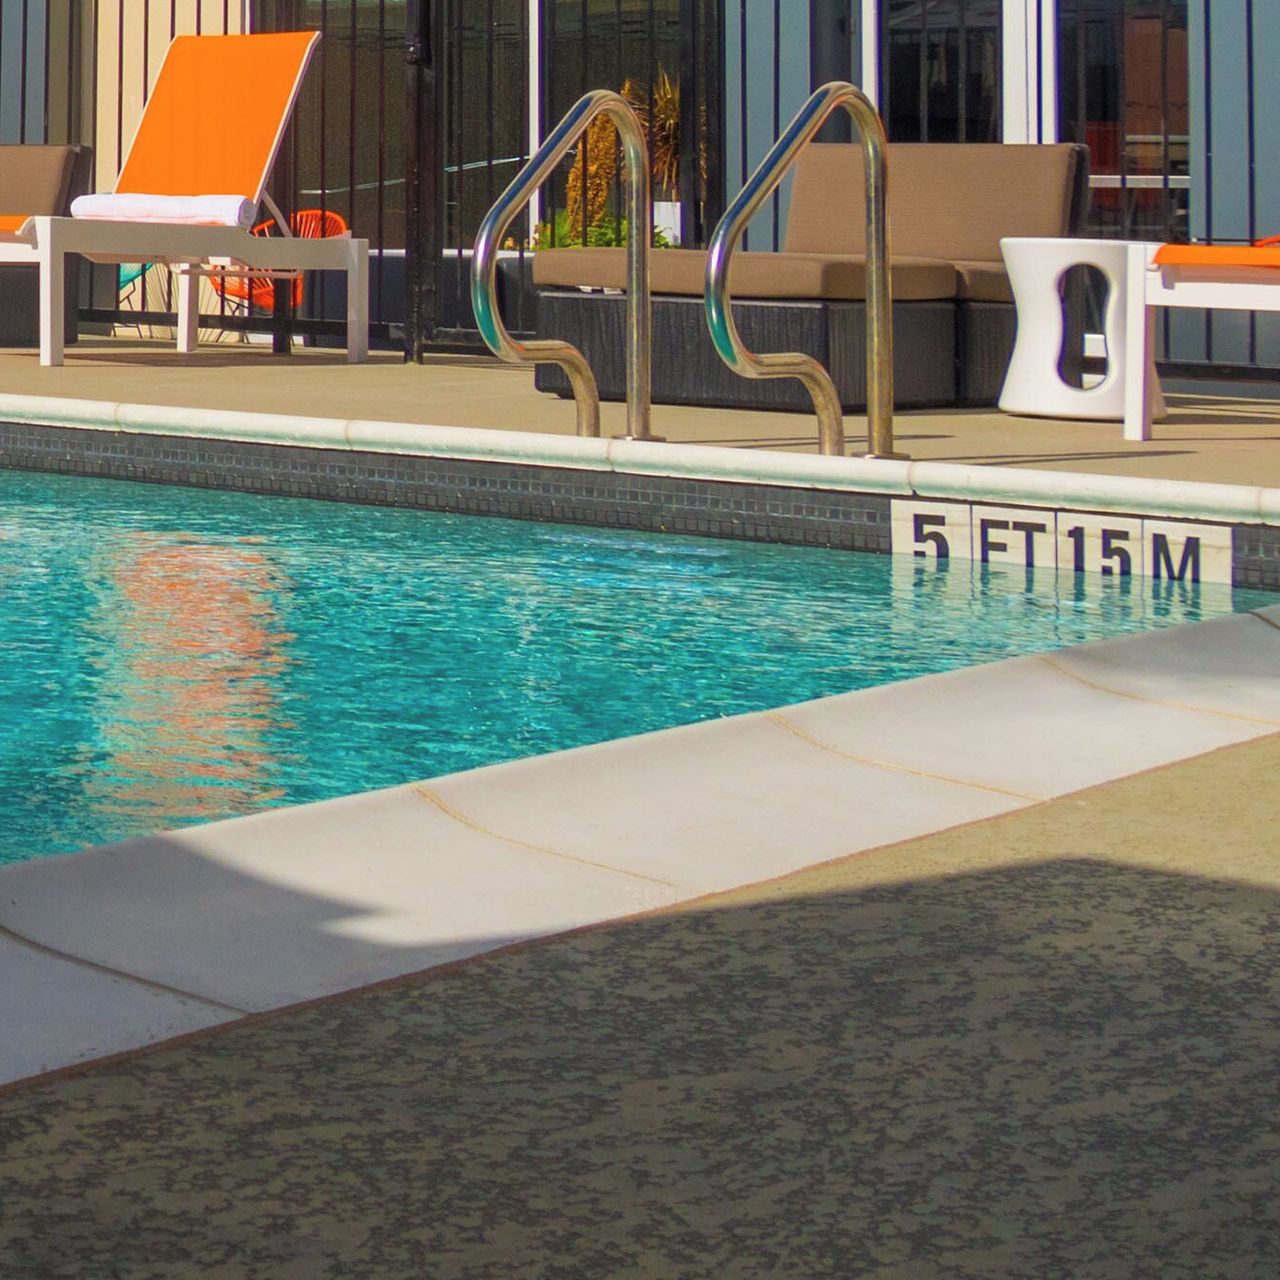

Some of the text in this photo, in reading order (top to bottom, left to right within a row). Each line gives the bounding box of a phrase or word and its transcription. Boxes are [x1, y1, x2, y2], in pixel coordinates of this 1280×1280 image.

[912, 513, 950, 559] 5
[979, 518, 1046, 568] FT
[1152, 532, 1201, 583] M
